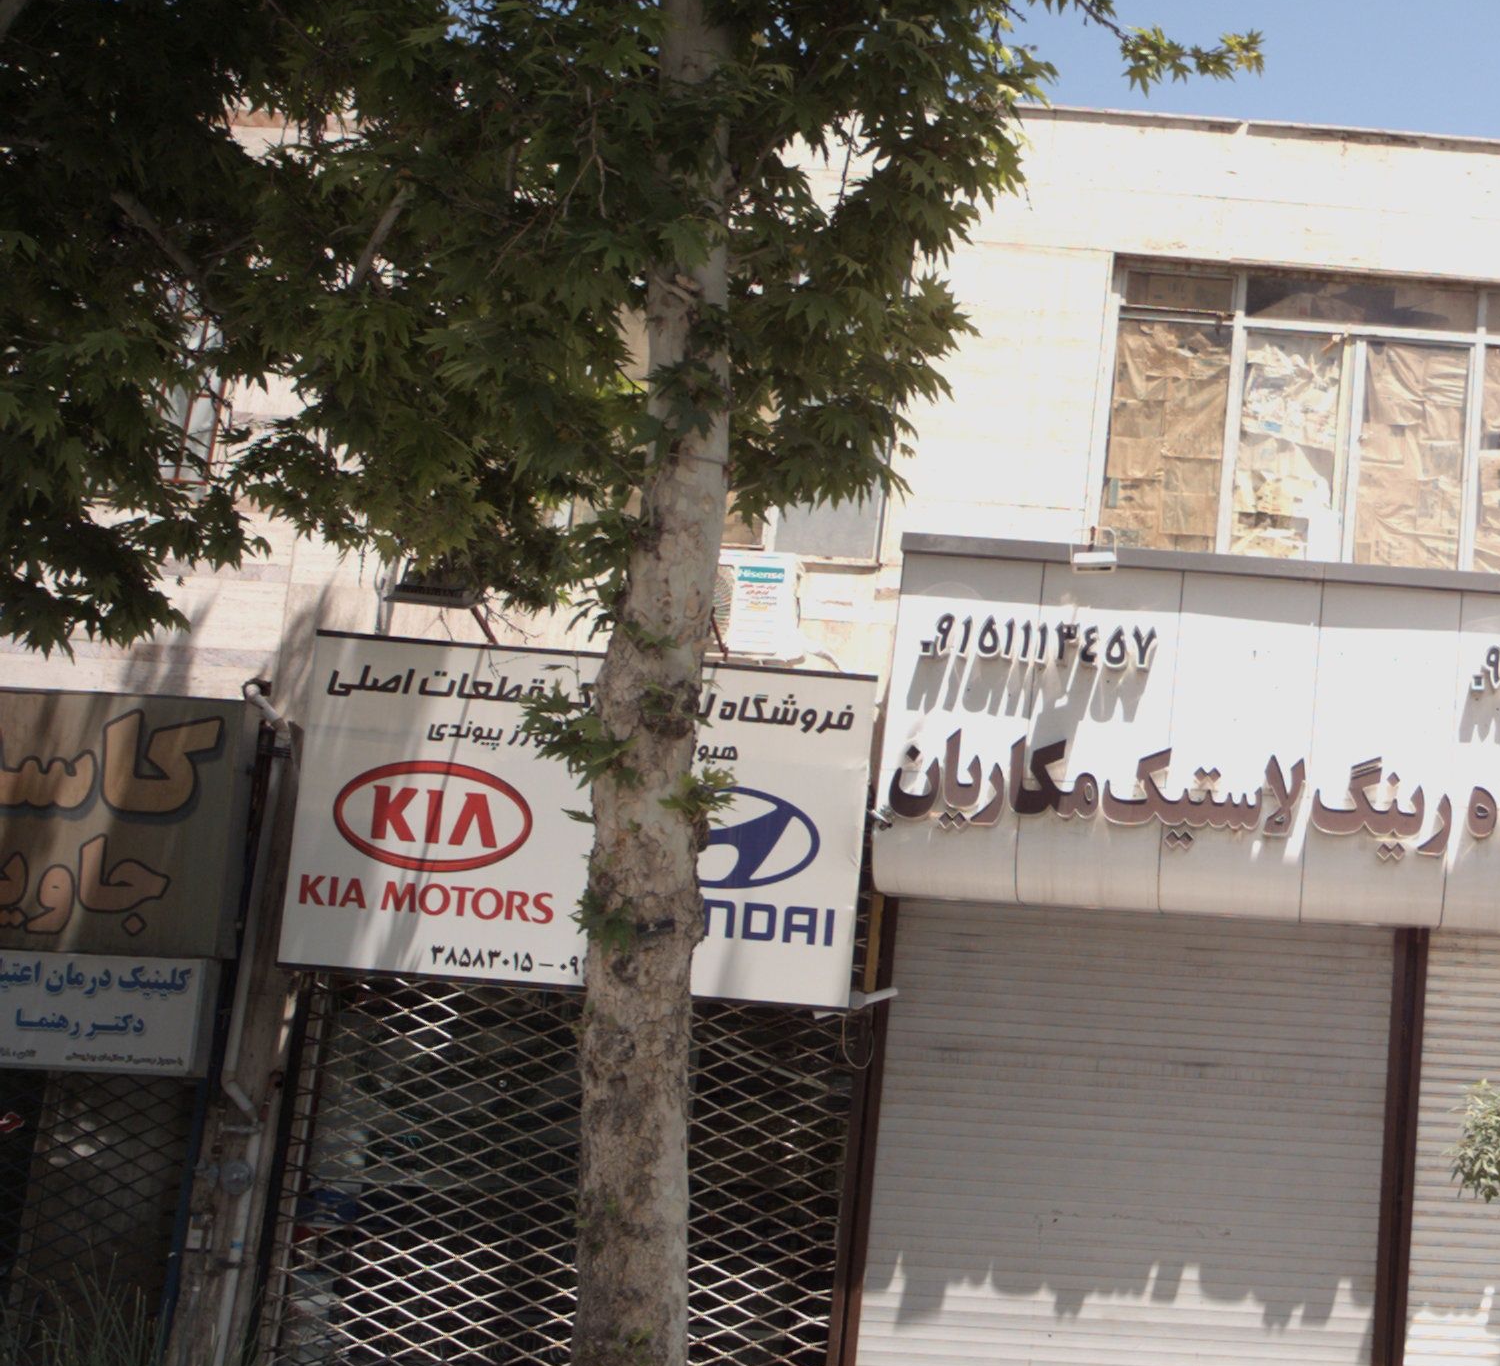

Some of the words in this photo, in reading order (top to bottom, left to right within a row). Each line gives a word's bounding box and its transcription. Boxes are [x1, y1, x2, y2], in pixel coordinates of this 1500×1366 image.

[327, 665, 415, 697] اصلی
[718, 693, 856, 734] فروشگاه
[371, 784, 498, 849] KIA
[1102, 746, 1306, 851] لاستیک
[1311, 756, 1453, 863] رینگ
[298, 874, 367, 910] KIA
[380, 881, 555, 925] MOTORS
[46, 962, 112, 995] درمان
[15, 1008, 81, 1037] رهنما
[86, 1013, 144, 1037] دکتر
